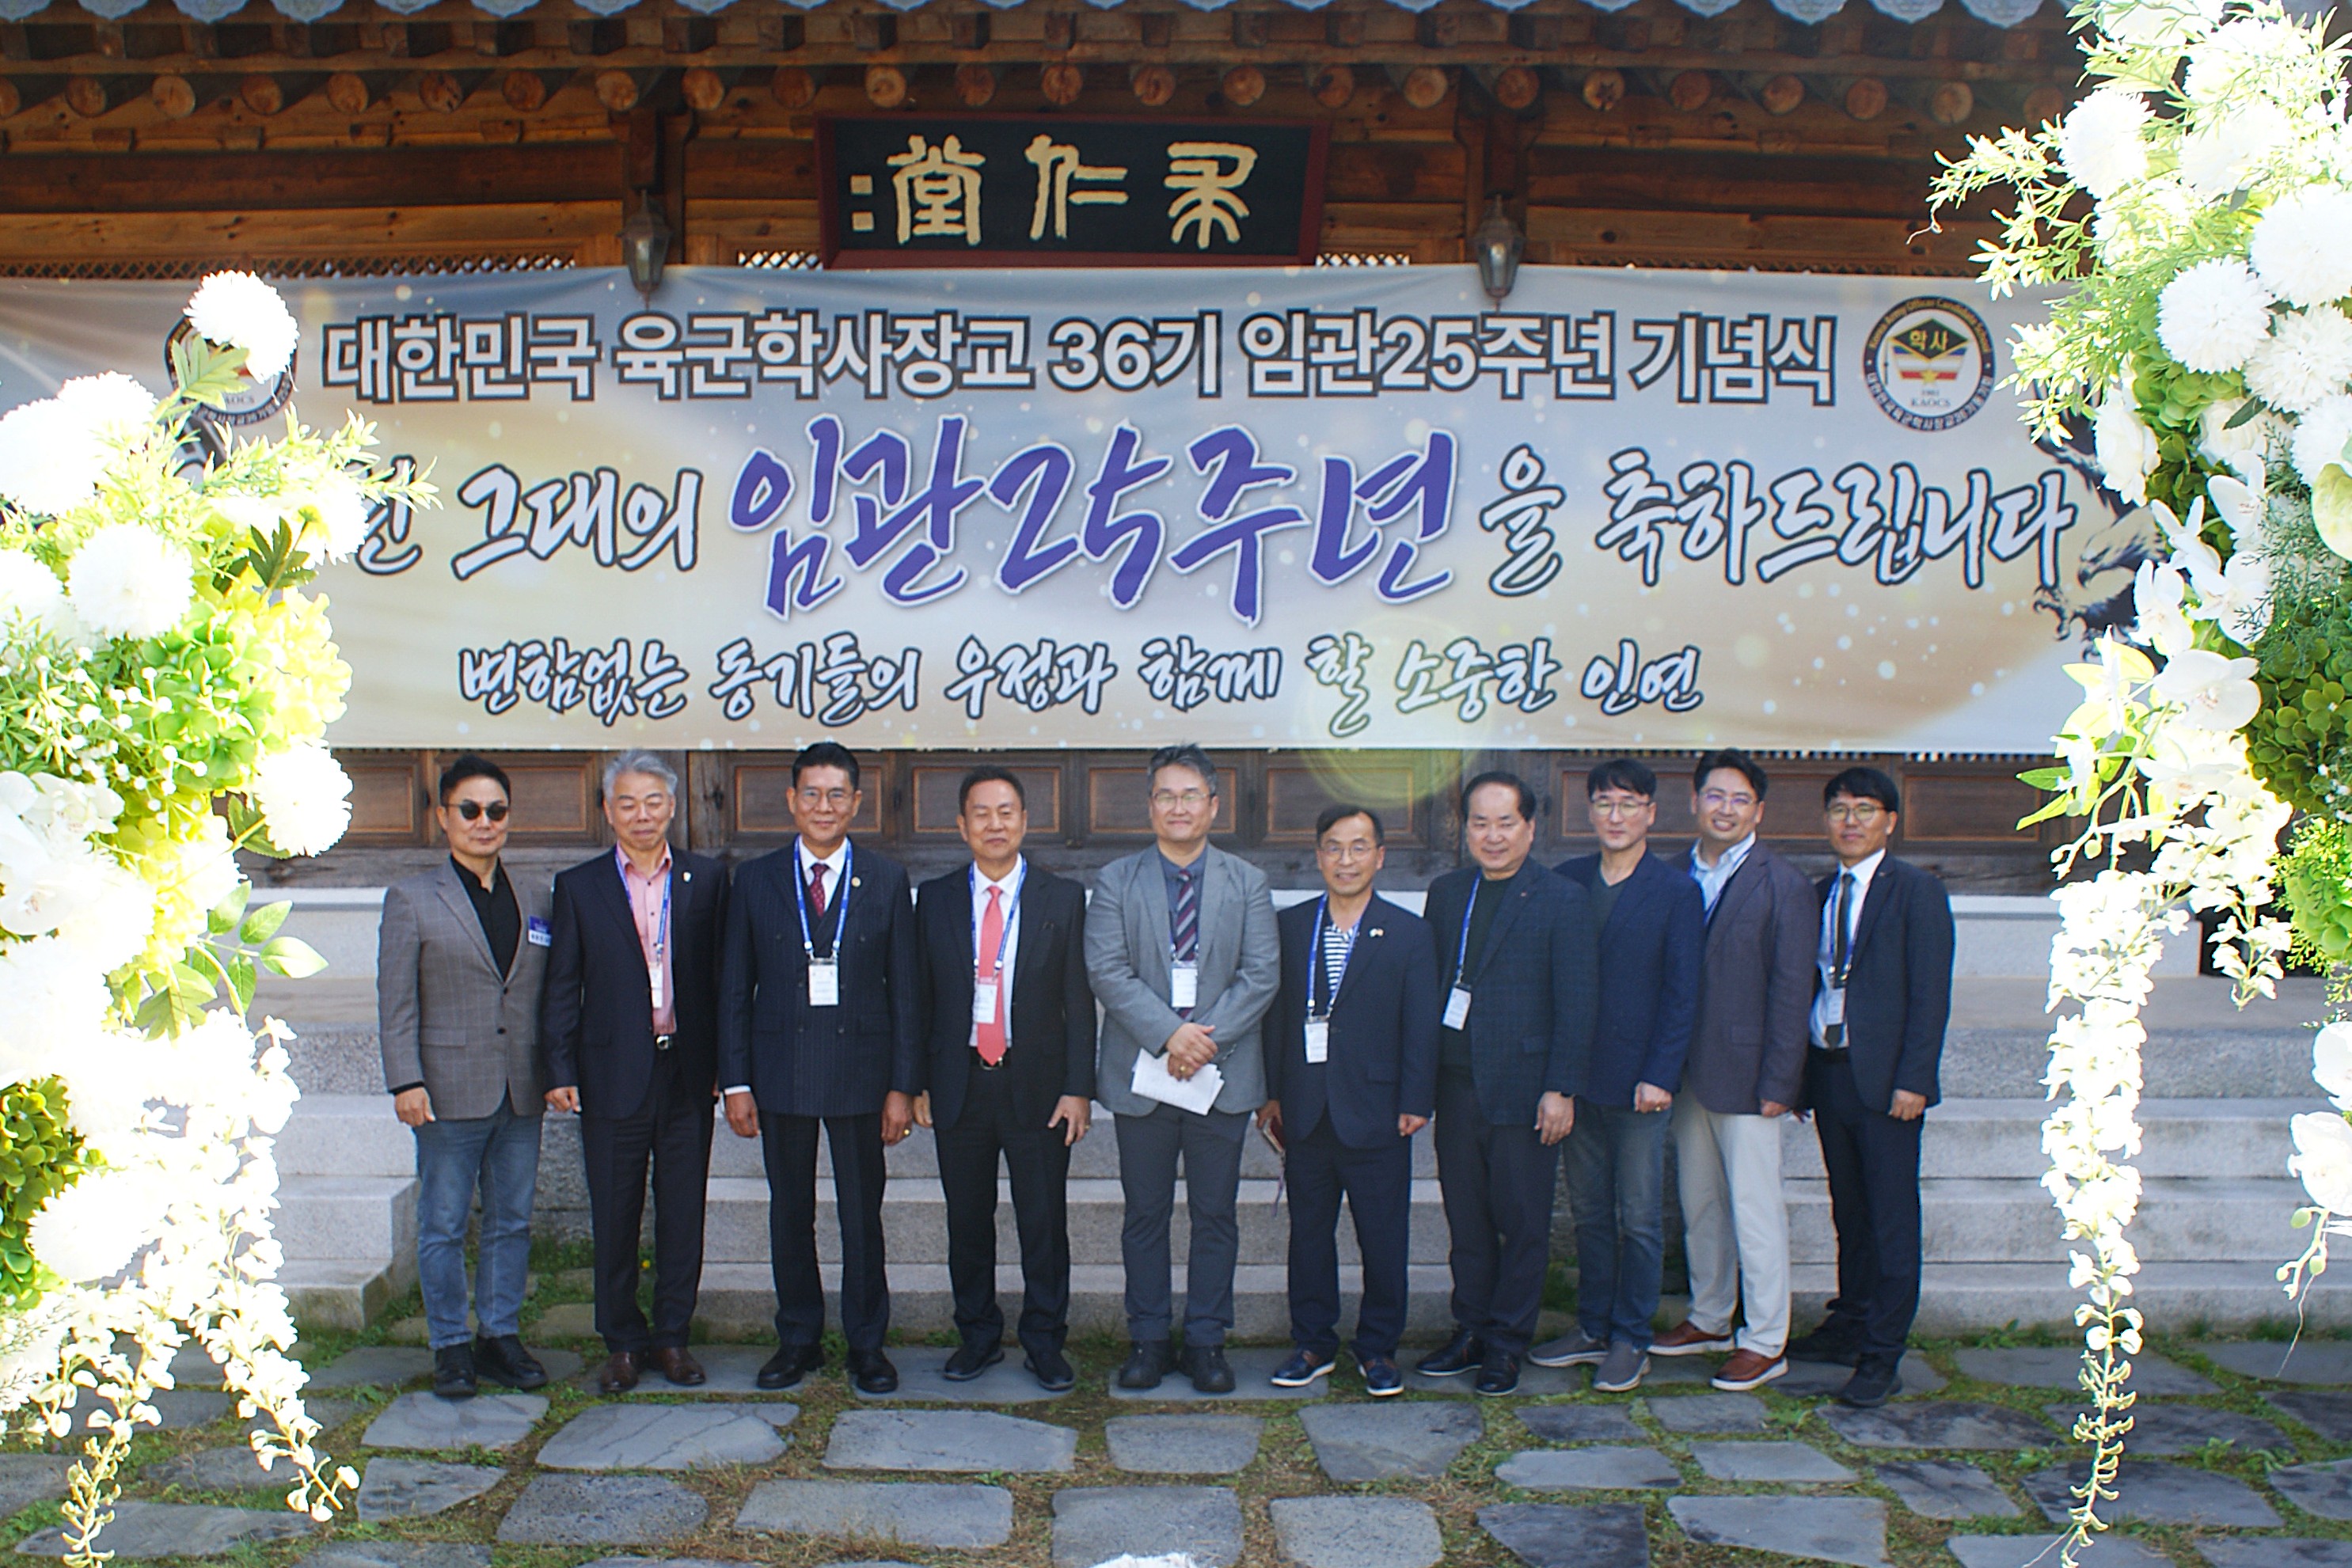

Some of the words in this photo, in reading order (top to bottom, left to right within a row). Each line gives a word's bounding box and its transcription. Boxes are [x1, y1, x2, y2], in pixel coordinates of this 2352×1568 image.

[321, 312, 598, 404] 대한민국
[611, 308, 1035, 403] 육군학사장교
[1048, 309, 1222, 398] 36기
[1239, 307, 1617, 401] 임관25주년
[1629, 312, 1838, 407] 기념식
[1909, 329, 1949, 351] 학사
[1911, 397, 1951, 407] KAOCS
[451, 464, 702, 581] 그대의
[1595, 448, 2077, 590] 축하드립니다
[460, 637, 690, 727] 변함없는
[709, 631, 923, 727] 동기들의
[946, 636, 1116, 719] 우정과
[1395, 637, 1562, 723] 소중한
[1582, 640, 1702, 716] 인연
